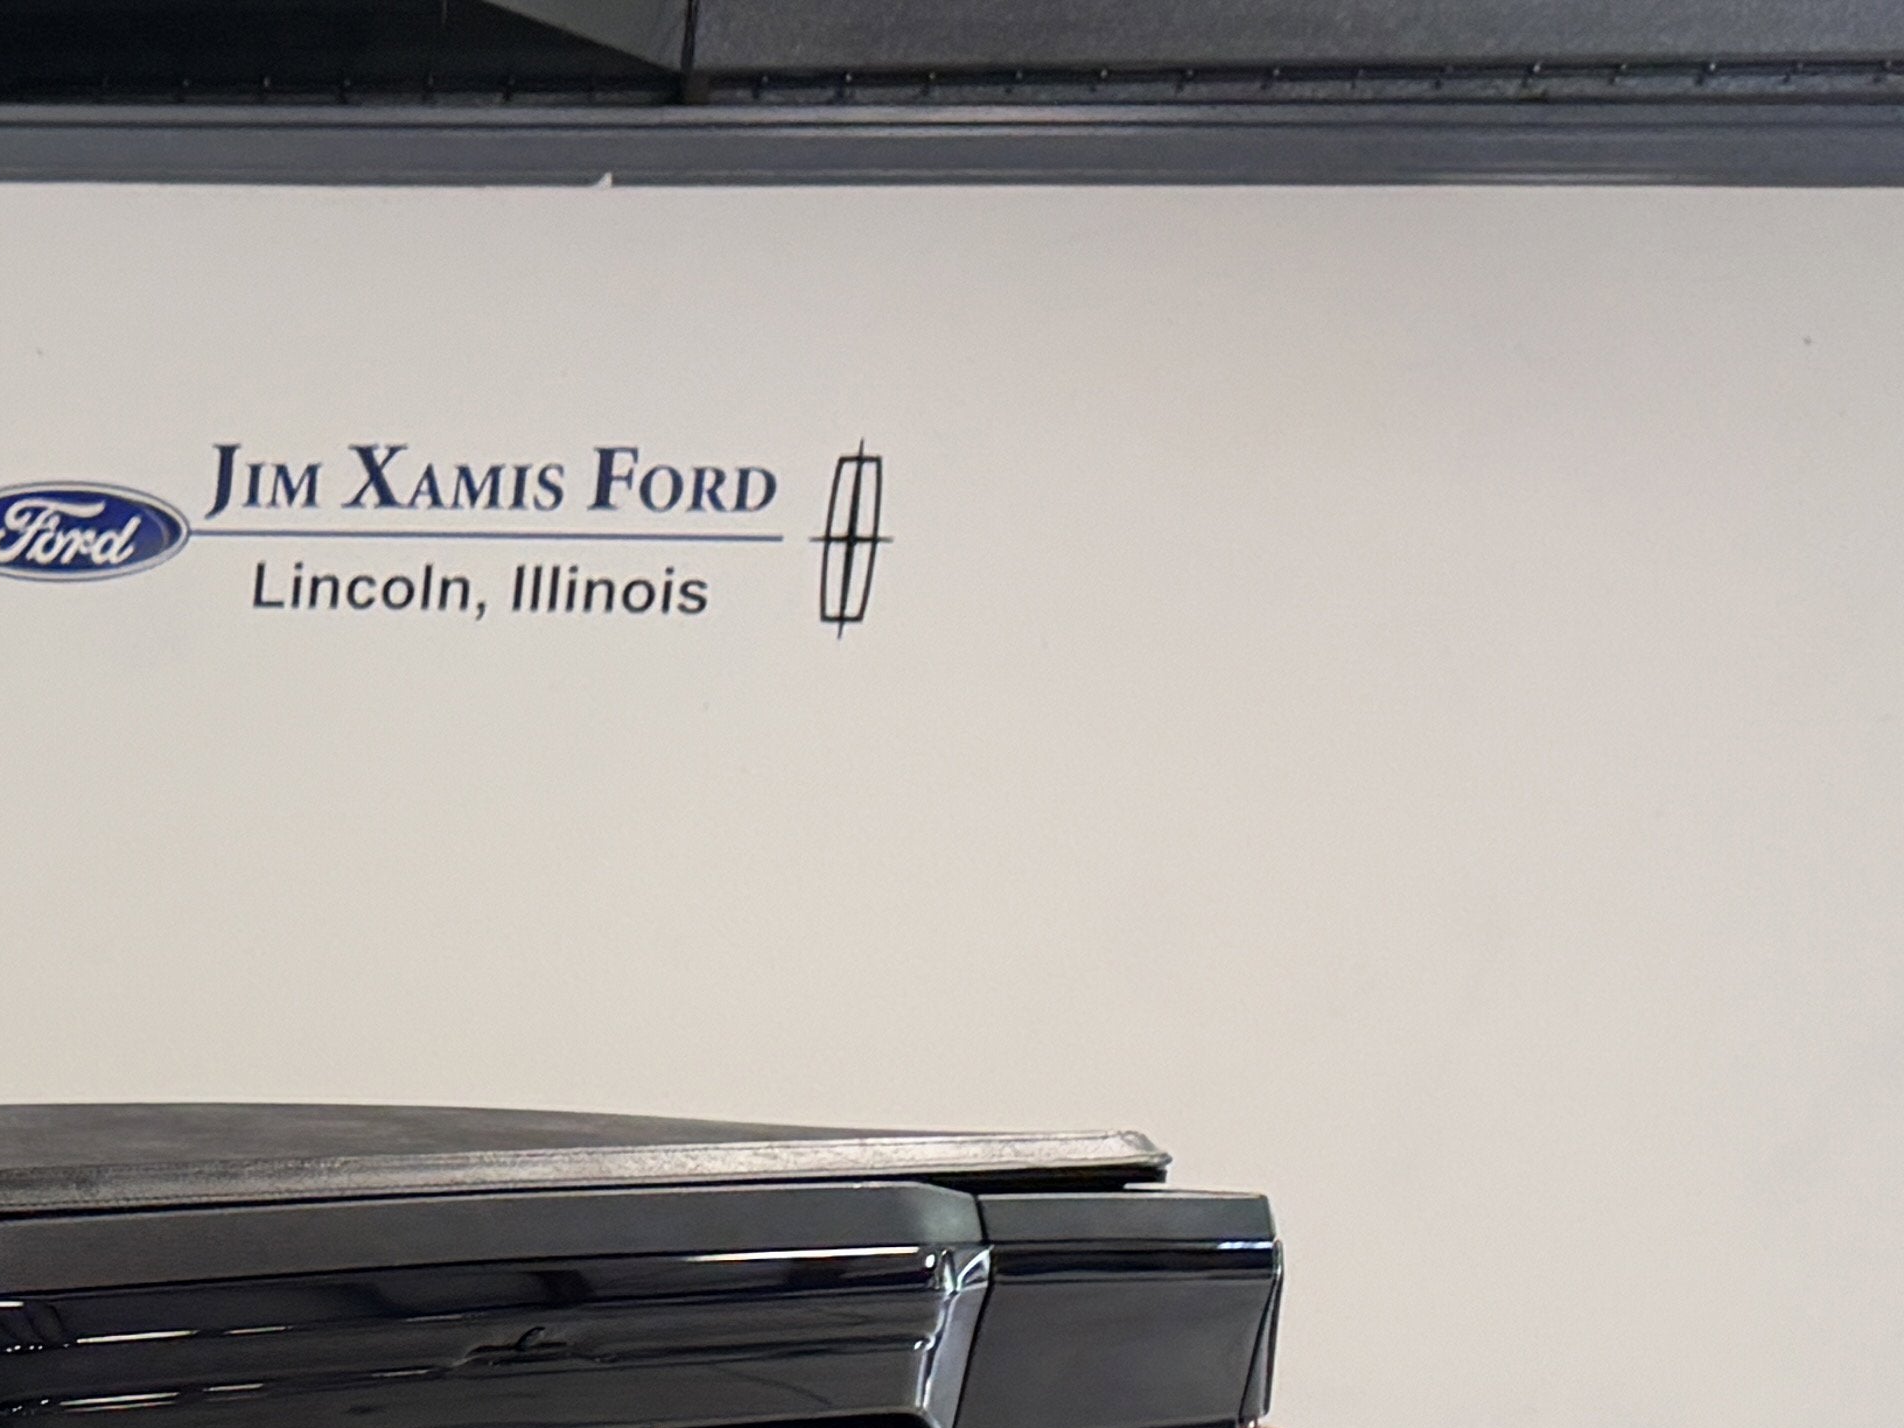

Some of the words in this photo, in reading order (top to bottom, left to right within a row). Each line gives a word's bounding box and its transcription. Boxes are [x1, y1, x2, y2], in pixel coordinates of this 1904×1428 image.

[204, 442, 323, 520] JIM
[339, 442, 566, 513] XAMIS
[586, 445, 779, 514] FORD
[252, 561, 489, 621] Lincoln,
[511, 563, 710, 615] Illinois
